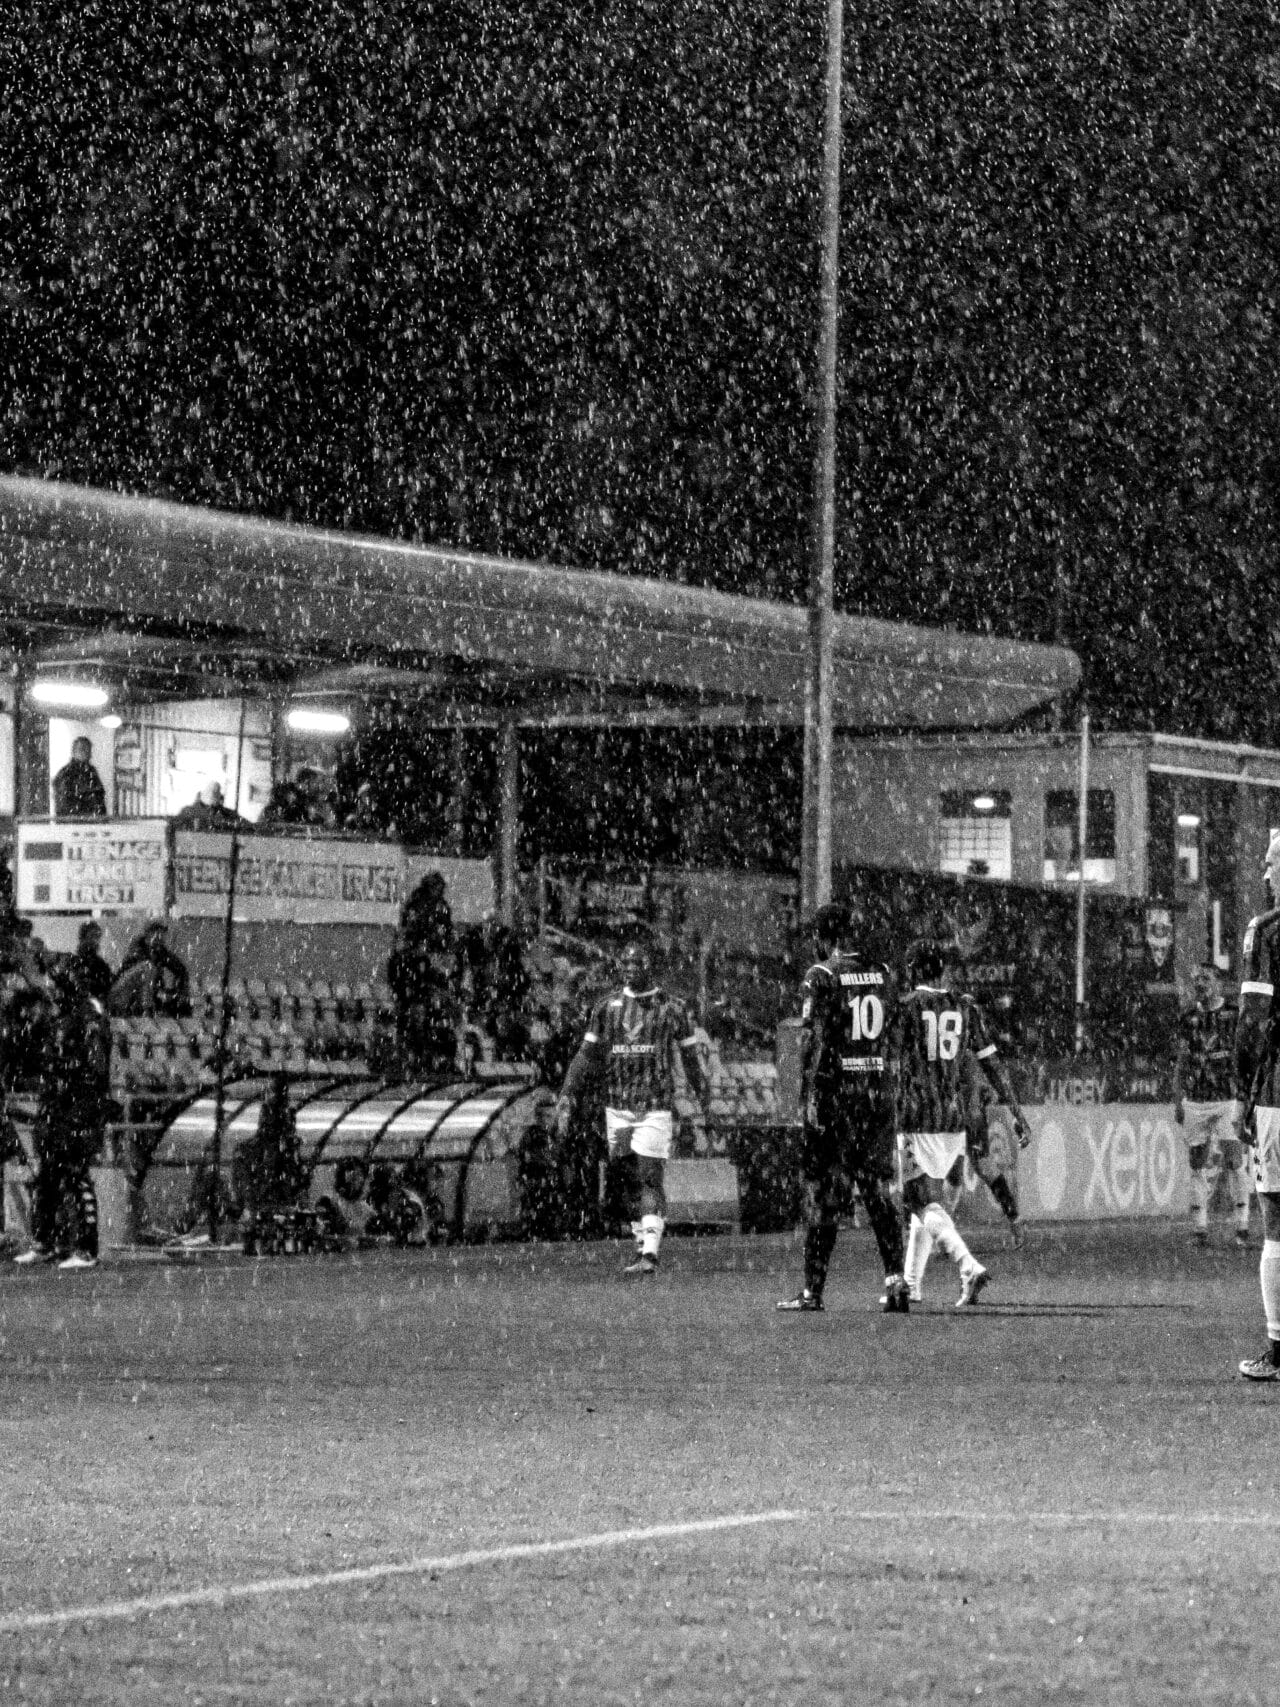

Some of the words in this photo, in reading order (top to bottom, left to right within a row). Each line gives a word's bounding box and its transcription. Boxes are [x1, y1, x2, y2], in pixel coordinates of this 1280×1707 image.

[67, 885, 135, 903] TRUST
[175, 860, 261, 892] TEENGE
[839, 972, 884, 986] MILLERS
[848, 995, 884, 1041] 10
[921, 1010, 963, 1062] 18
[1082, 1120, 1176, 1209] xero
